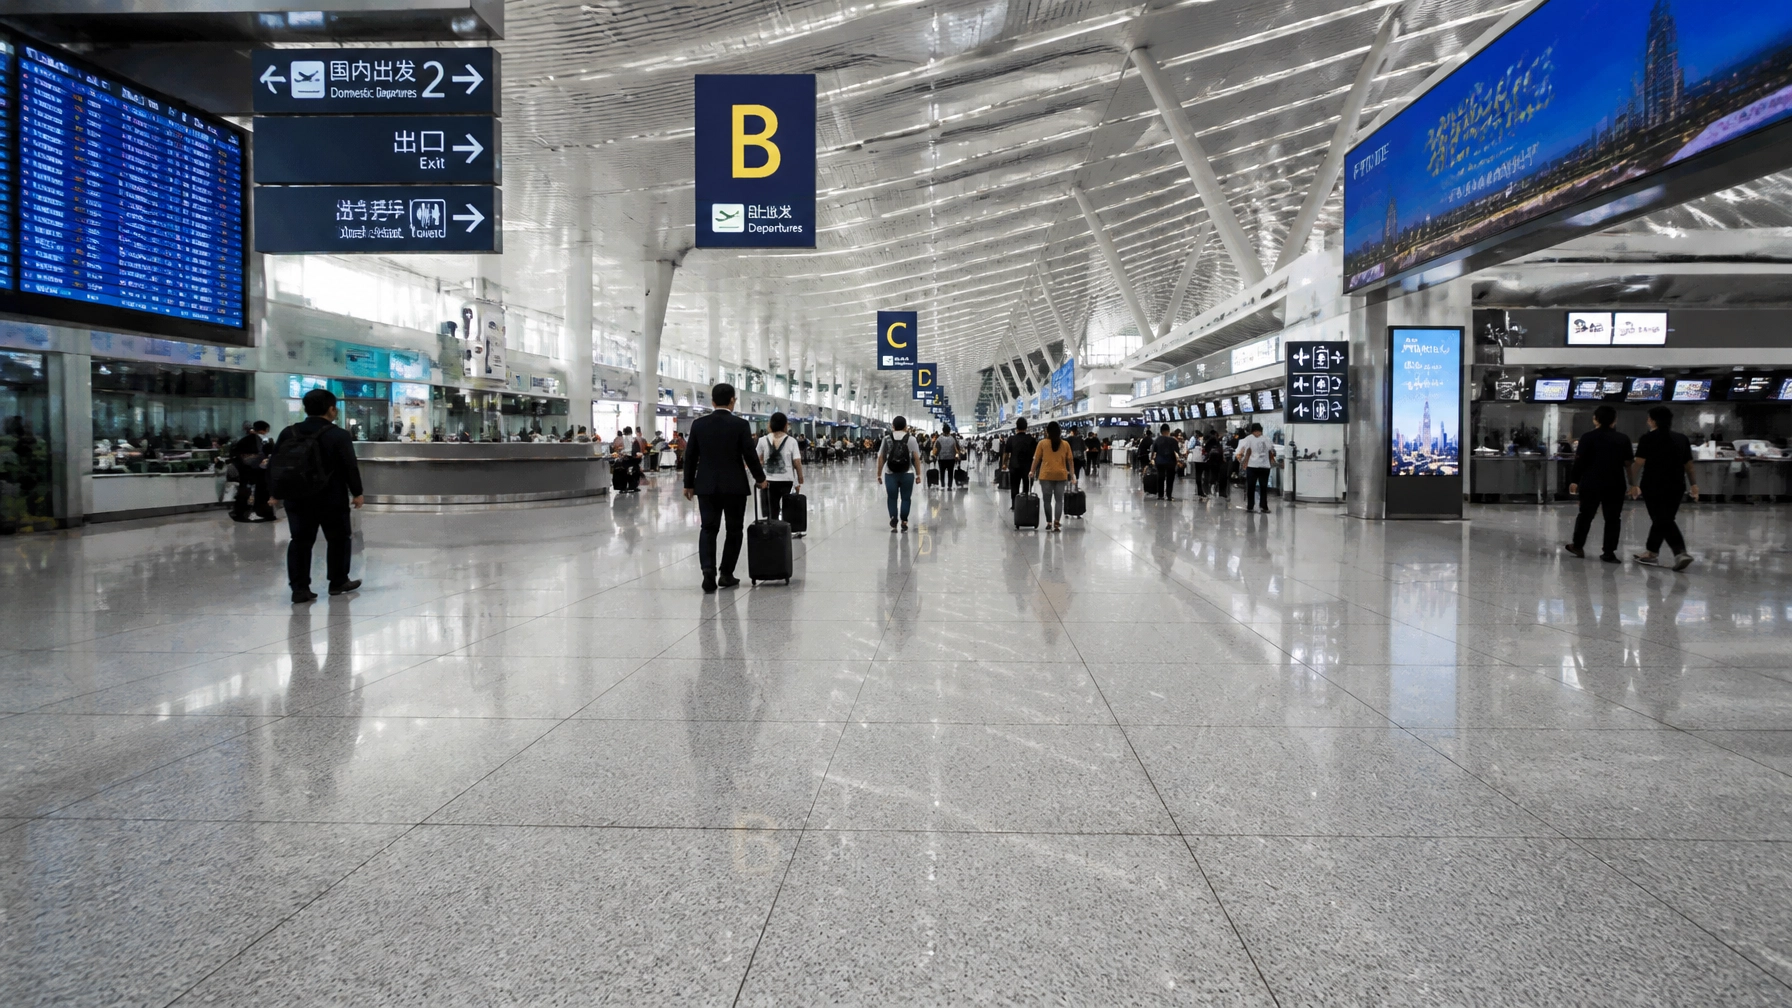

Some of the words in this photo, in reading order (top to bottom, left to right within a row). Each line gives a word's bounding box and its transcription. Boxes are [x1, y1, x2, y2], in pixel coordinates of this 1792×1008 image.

[330, 60, 416, 82] 国内出发
[421, 60, 446, 98] 2
[394, 130, 445, 153] 出口
[732, 104, 781, 178] B
[419, 157, 445, 169] Exit
[748, 222, 803, 235] Departures
[886, 322, 908, 349] C
